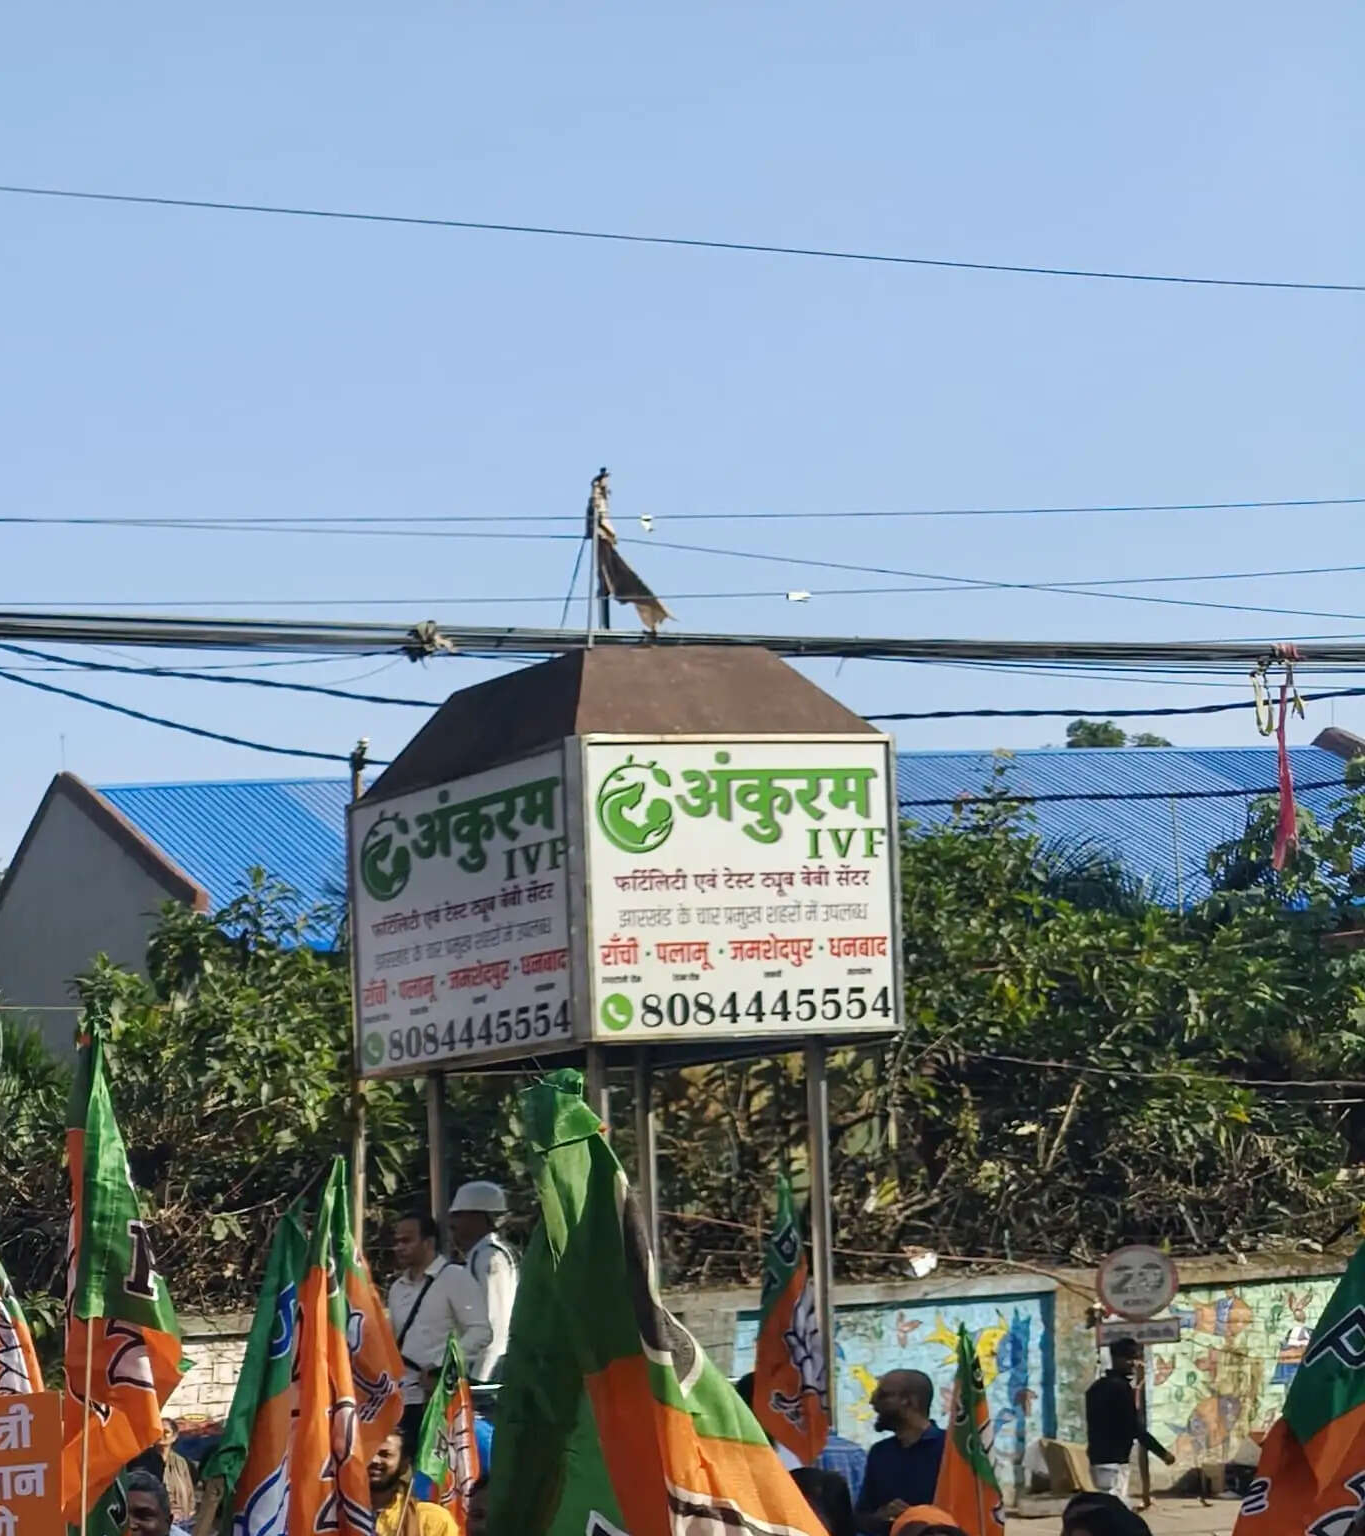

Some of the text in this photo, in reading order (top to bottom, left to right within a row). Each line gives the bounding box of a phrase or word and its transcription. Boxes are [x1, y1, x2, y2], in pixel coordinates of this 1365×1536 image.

[675, 751, 878, 845] अंकुरम
[411, 776, 560, 873] अंकुरम
[805, 828, 886, 859] IVF
[654, 940, 715, 970] पलामू
[728, 933, 814, 967] जमशेदपुर
[828, 935, 888, 959] धनबाद
[388, 999, 571, 1061] 8084445554
[641, 986, 893, 1028] 8084445554
